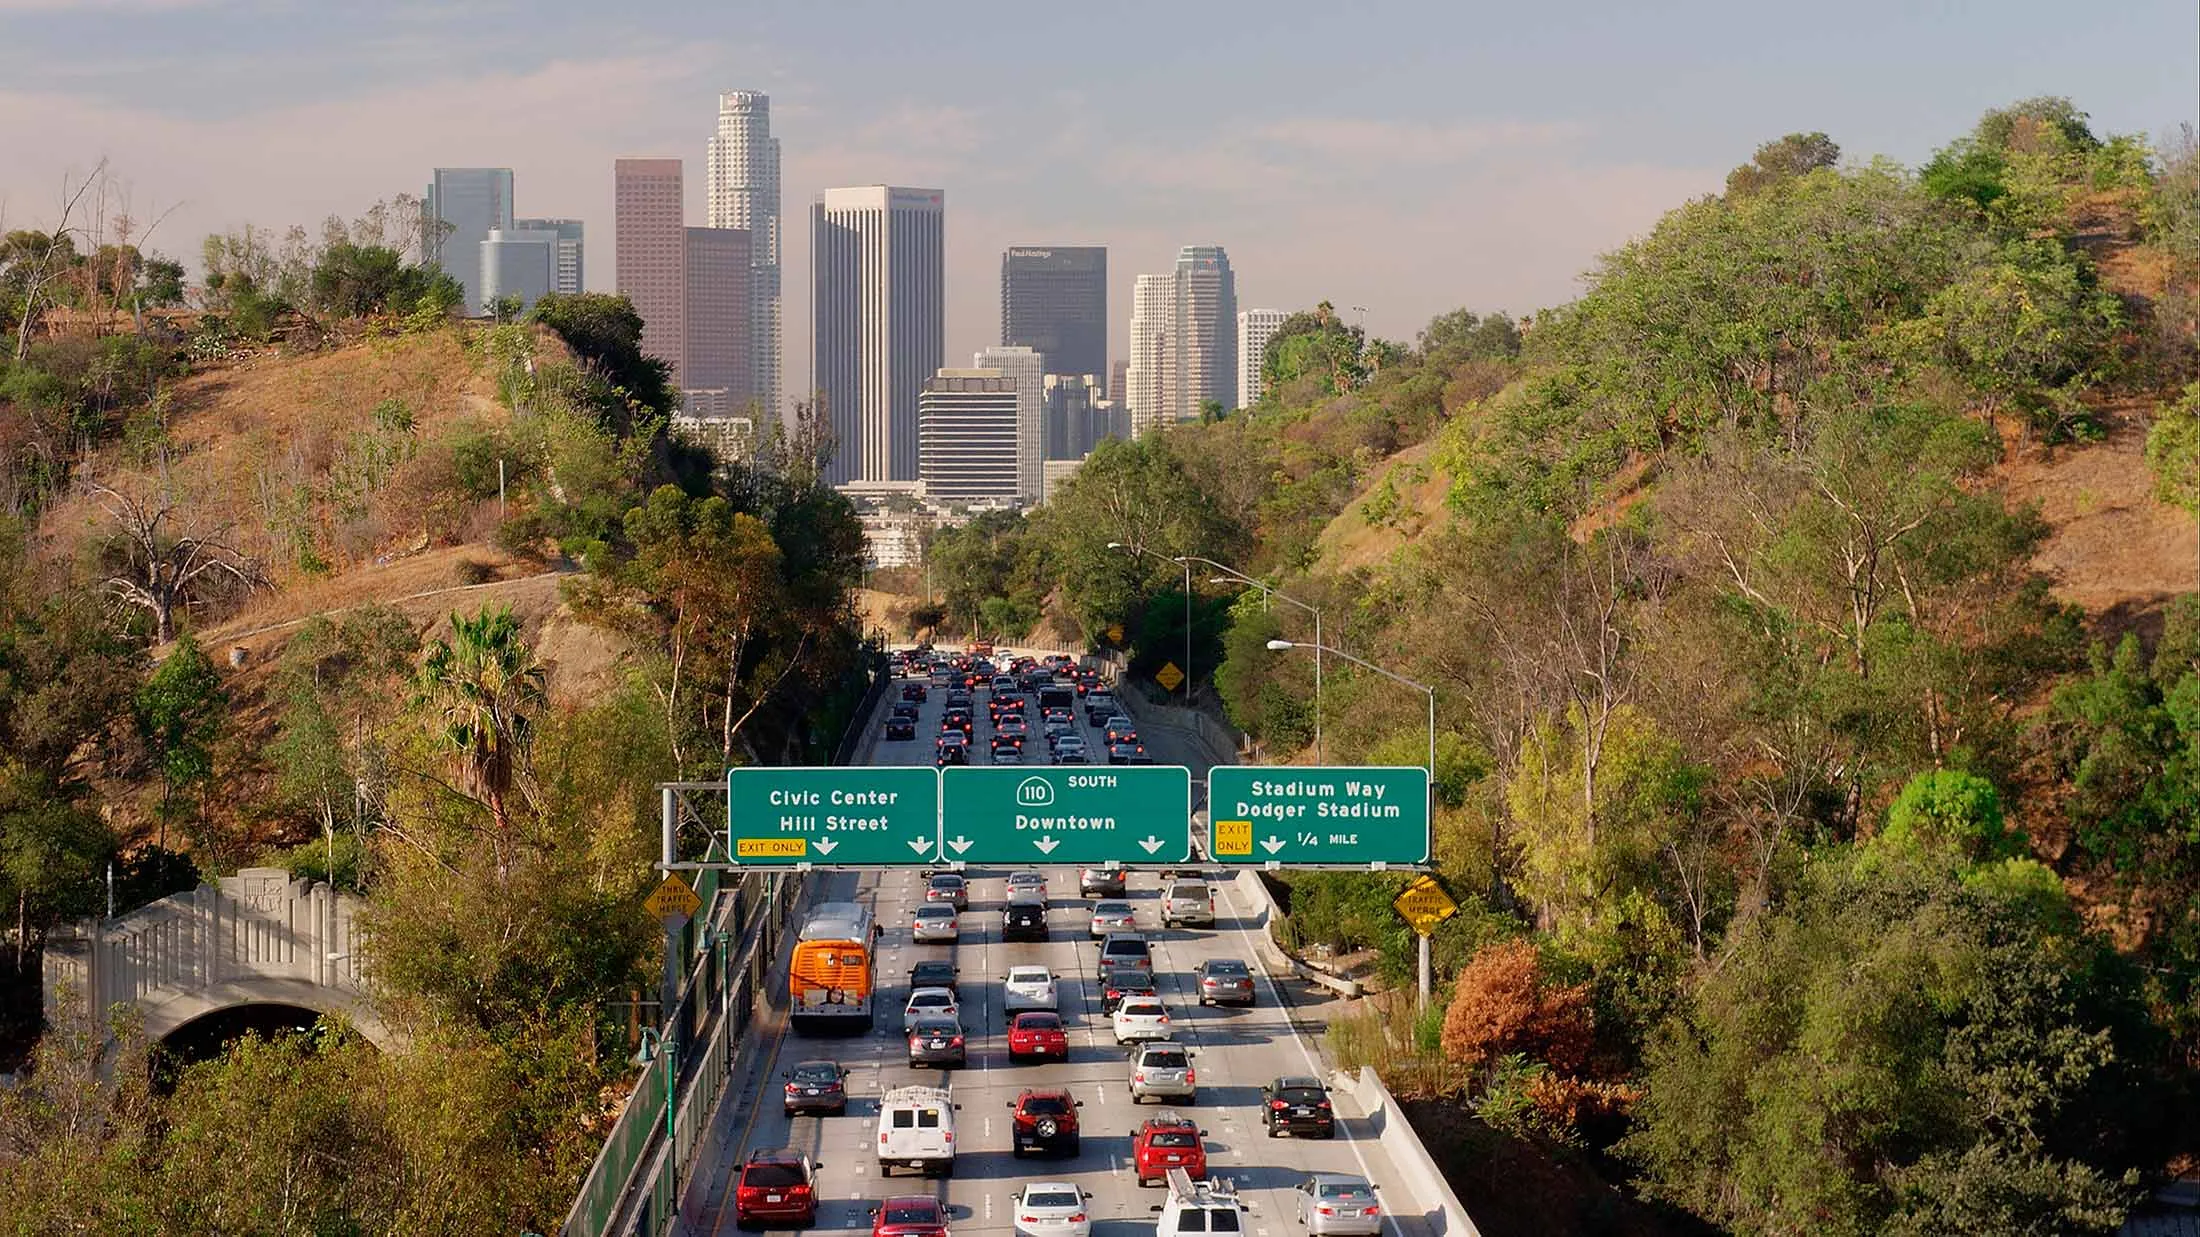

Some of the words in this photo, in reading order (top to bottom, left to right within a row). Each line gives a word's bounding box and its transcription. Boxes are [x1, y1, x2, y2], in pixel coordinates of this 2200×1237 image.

[1068, 775, 1117, 788] SOUTH
[1023, 786, 1046, 801] 110
[1251, 780, 1335, 797] Stadium
[1345, 781, 1386, 799] Way
[770, 790, 820, 806] Civic
[831, 790, 898, 805] Center
[1236, 802, 1306, 821] Dodger
[1317, 802, 1400, 818] Stadium
[780, 816, 815, 831] Hill
[826, 815, 888, 831] Street
[1015, 814, 1115, 830] Downtown
[1218, 825, 1249, 835] EXIT
[1217, 841, 1249, 851] ONLY
[1329, 834, 1359, 845] MILE
[739, 843, 765, 853] EXIT
[772, 843, 802, 853] ONLY
[656, 895, 691, 904] TRAFFIC
[1408, 896, 1443, 904] TRAFFIC
